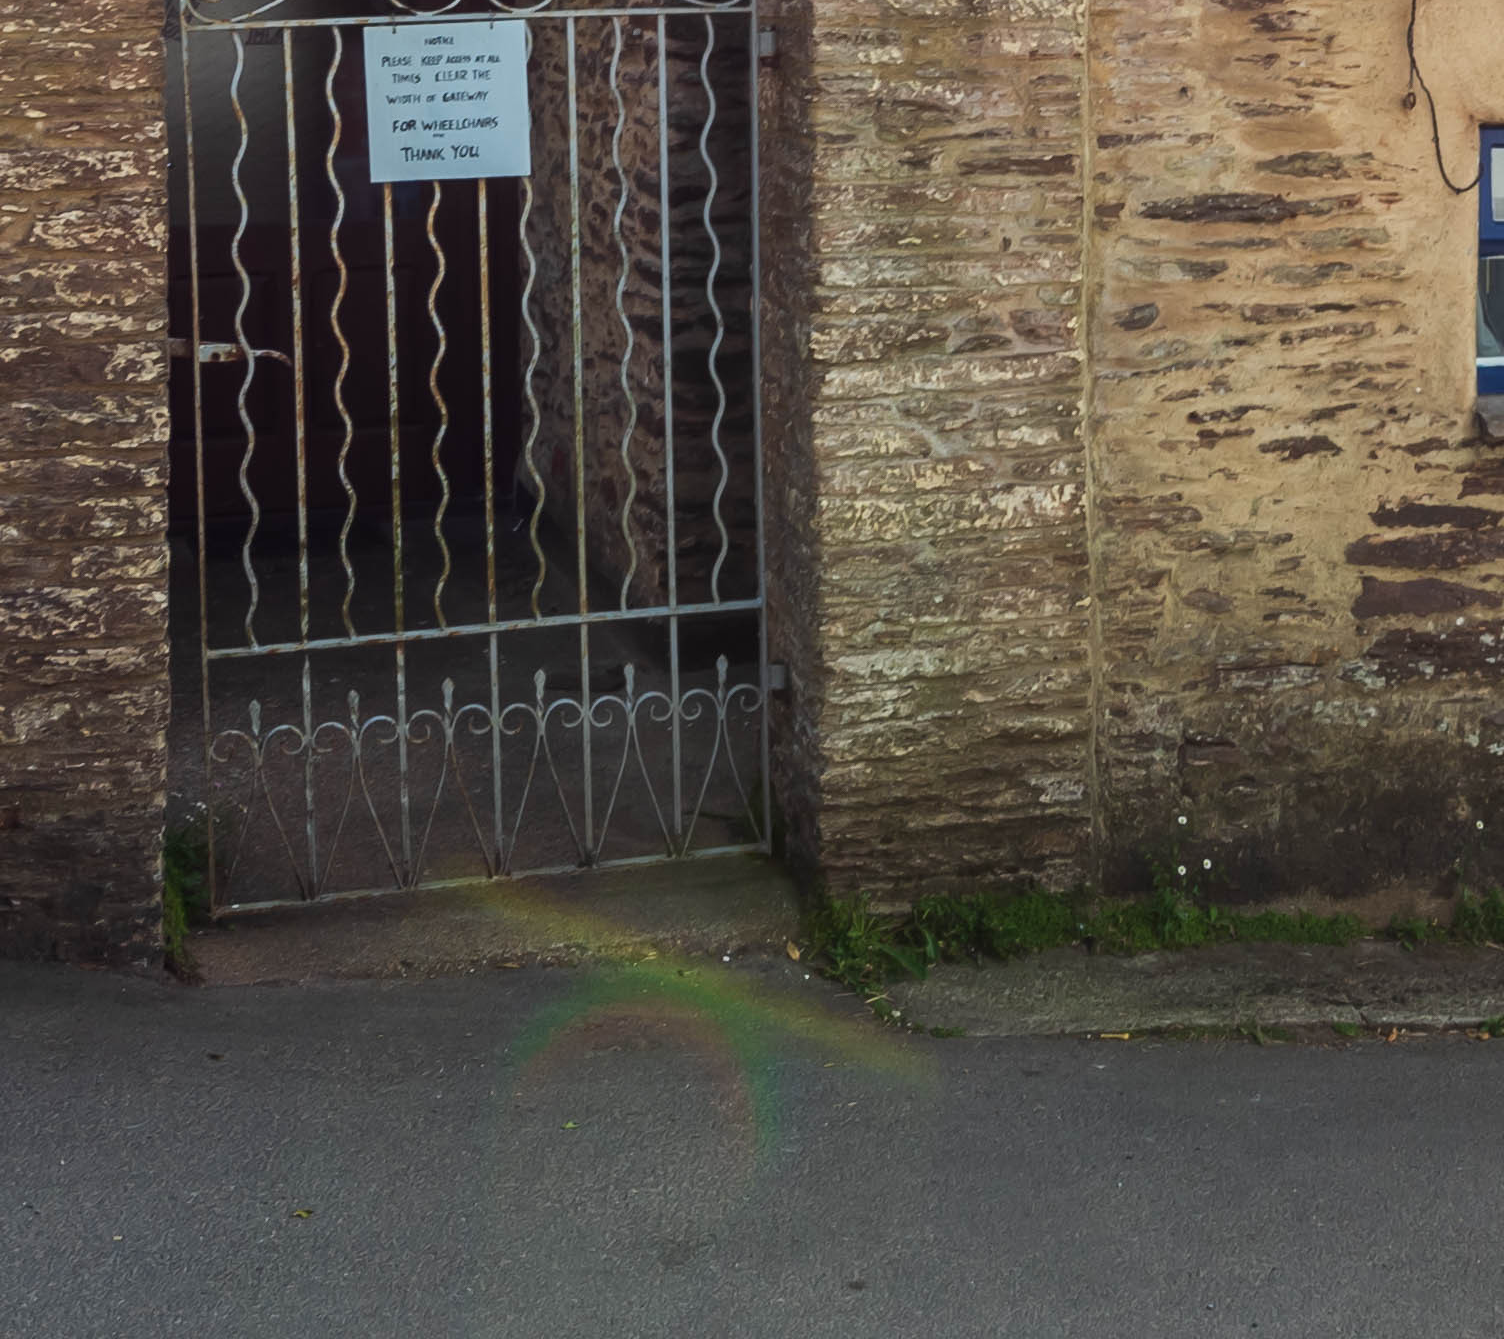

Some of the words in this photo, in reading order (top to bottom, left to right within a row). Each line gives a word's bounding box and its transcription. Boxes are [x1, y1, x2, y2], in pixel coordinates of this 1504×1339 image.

[381, 55, 413, 67] PLEASE
[421, 54, 443, 66] KEEP
[475, 54, 485, 63] AT
[487, 54, 501, 63] ALL
[392, 73, 421, 84] TIMES
[435, 69, 468, 82] CLEAR
[473, 69, 492, 80] THE
[386, 94, 421, 105] WIDTH
[442, 91, 490, 103] GATEWAY
[392, 119, 417, 133] FOR
[422, 116, 499, 132] WHEELCHAIRS
[400, 146, 446, 163] THANK
[451, 144, 481, 160] YOU
